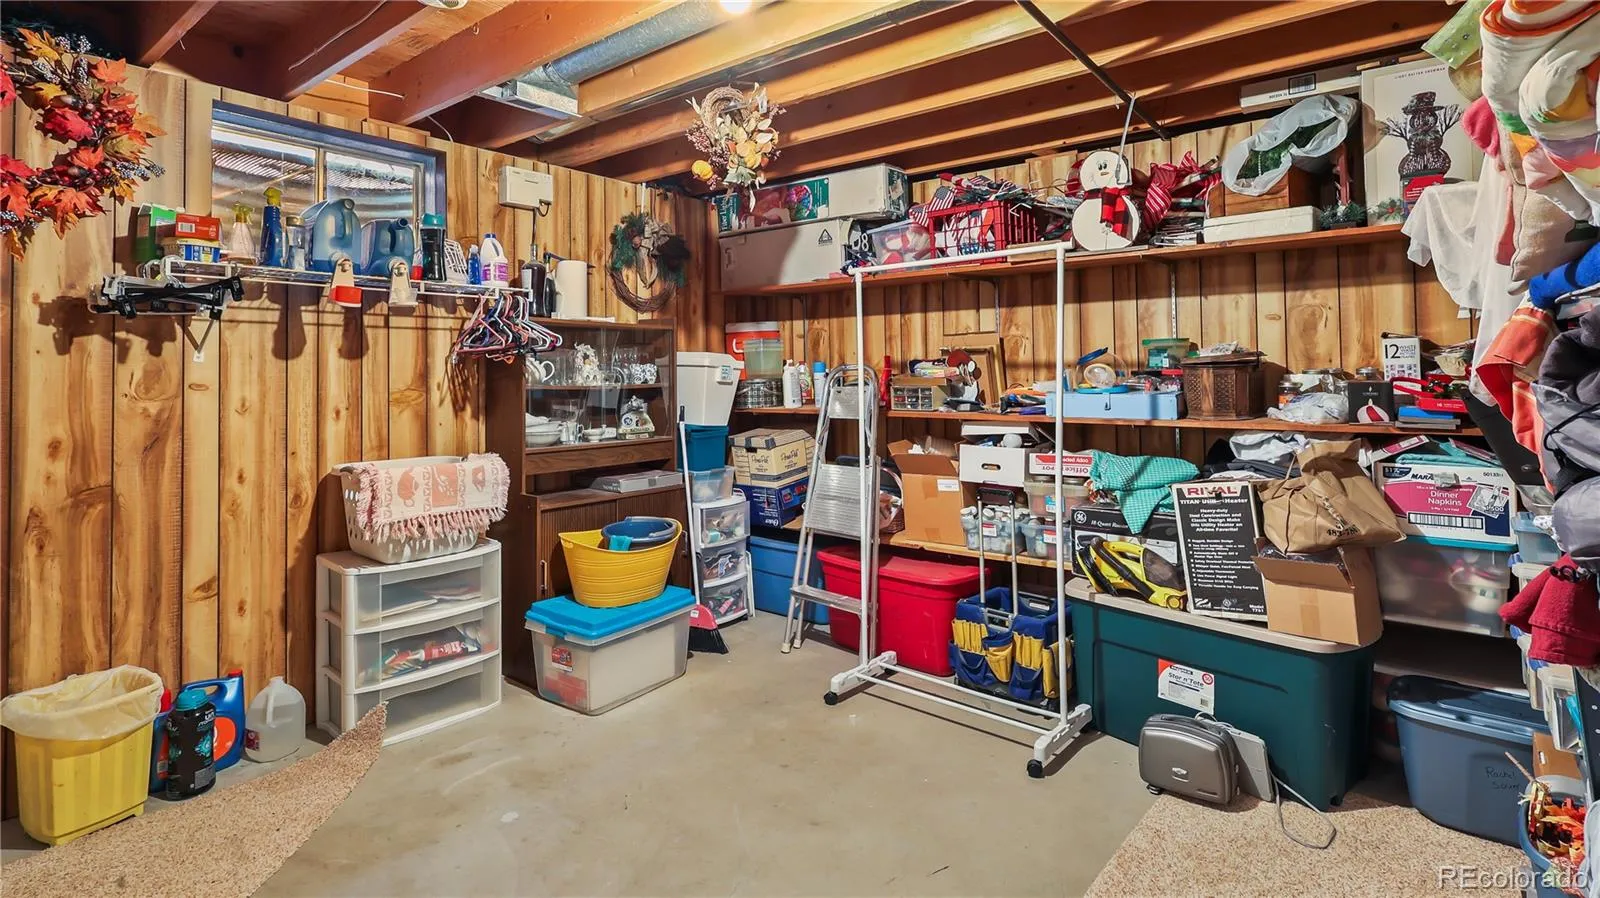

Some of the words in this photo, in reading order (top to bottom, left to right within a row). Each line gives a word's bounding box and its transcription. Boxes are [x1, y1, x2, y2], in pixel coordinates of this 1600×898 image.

[1384, 344, 1401, 359] 12
[1065, 466, 1089, 474] Office
[1187, 486, 1238, 496] RIVAL
[1430, 490, 1459, 498] Dinner
[1427, 498, 1462, 506] Napkins
